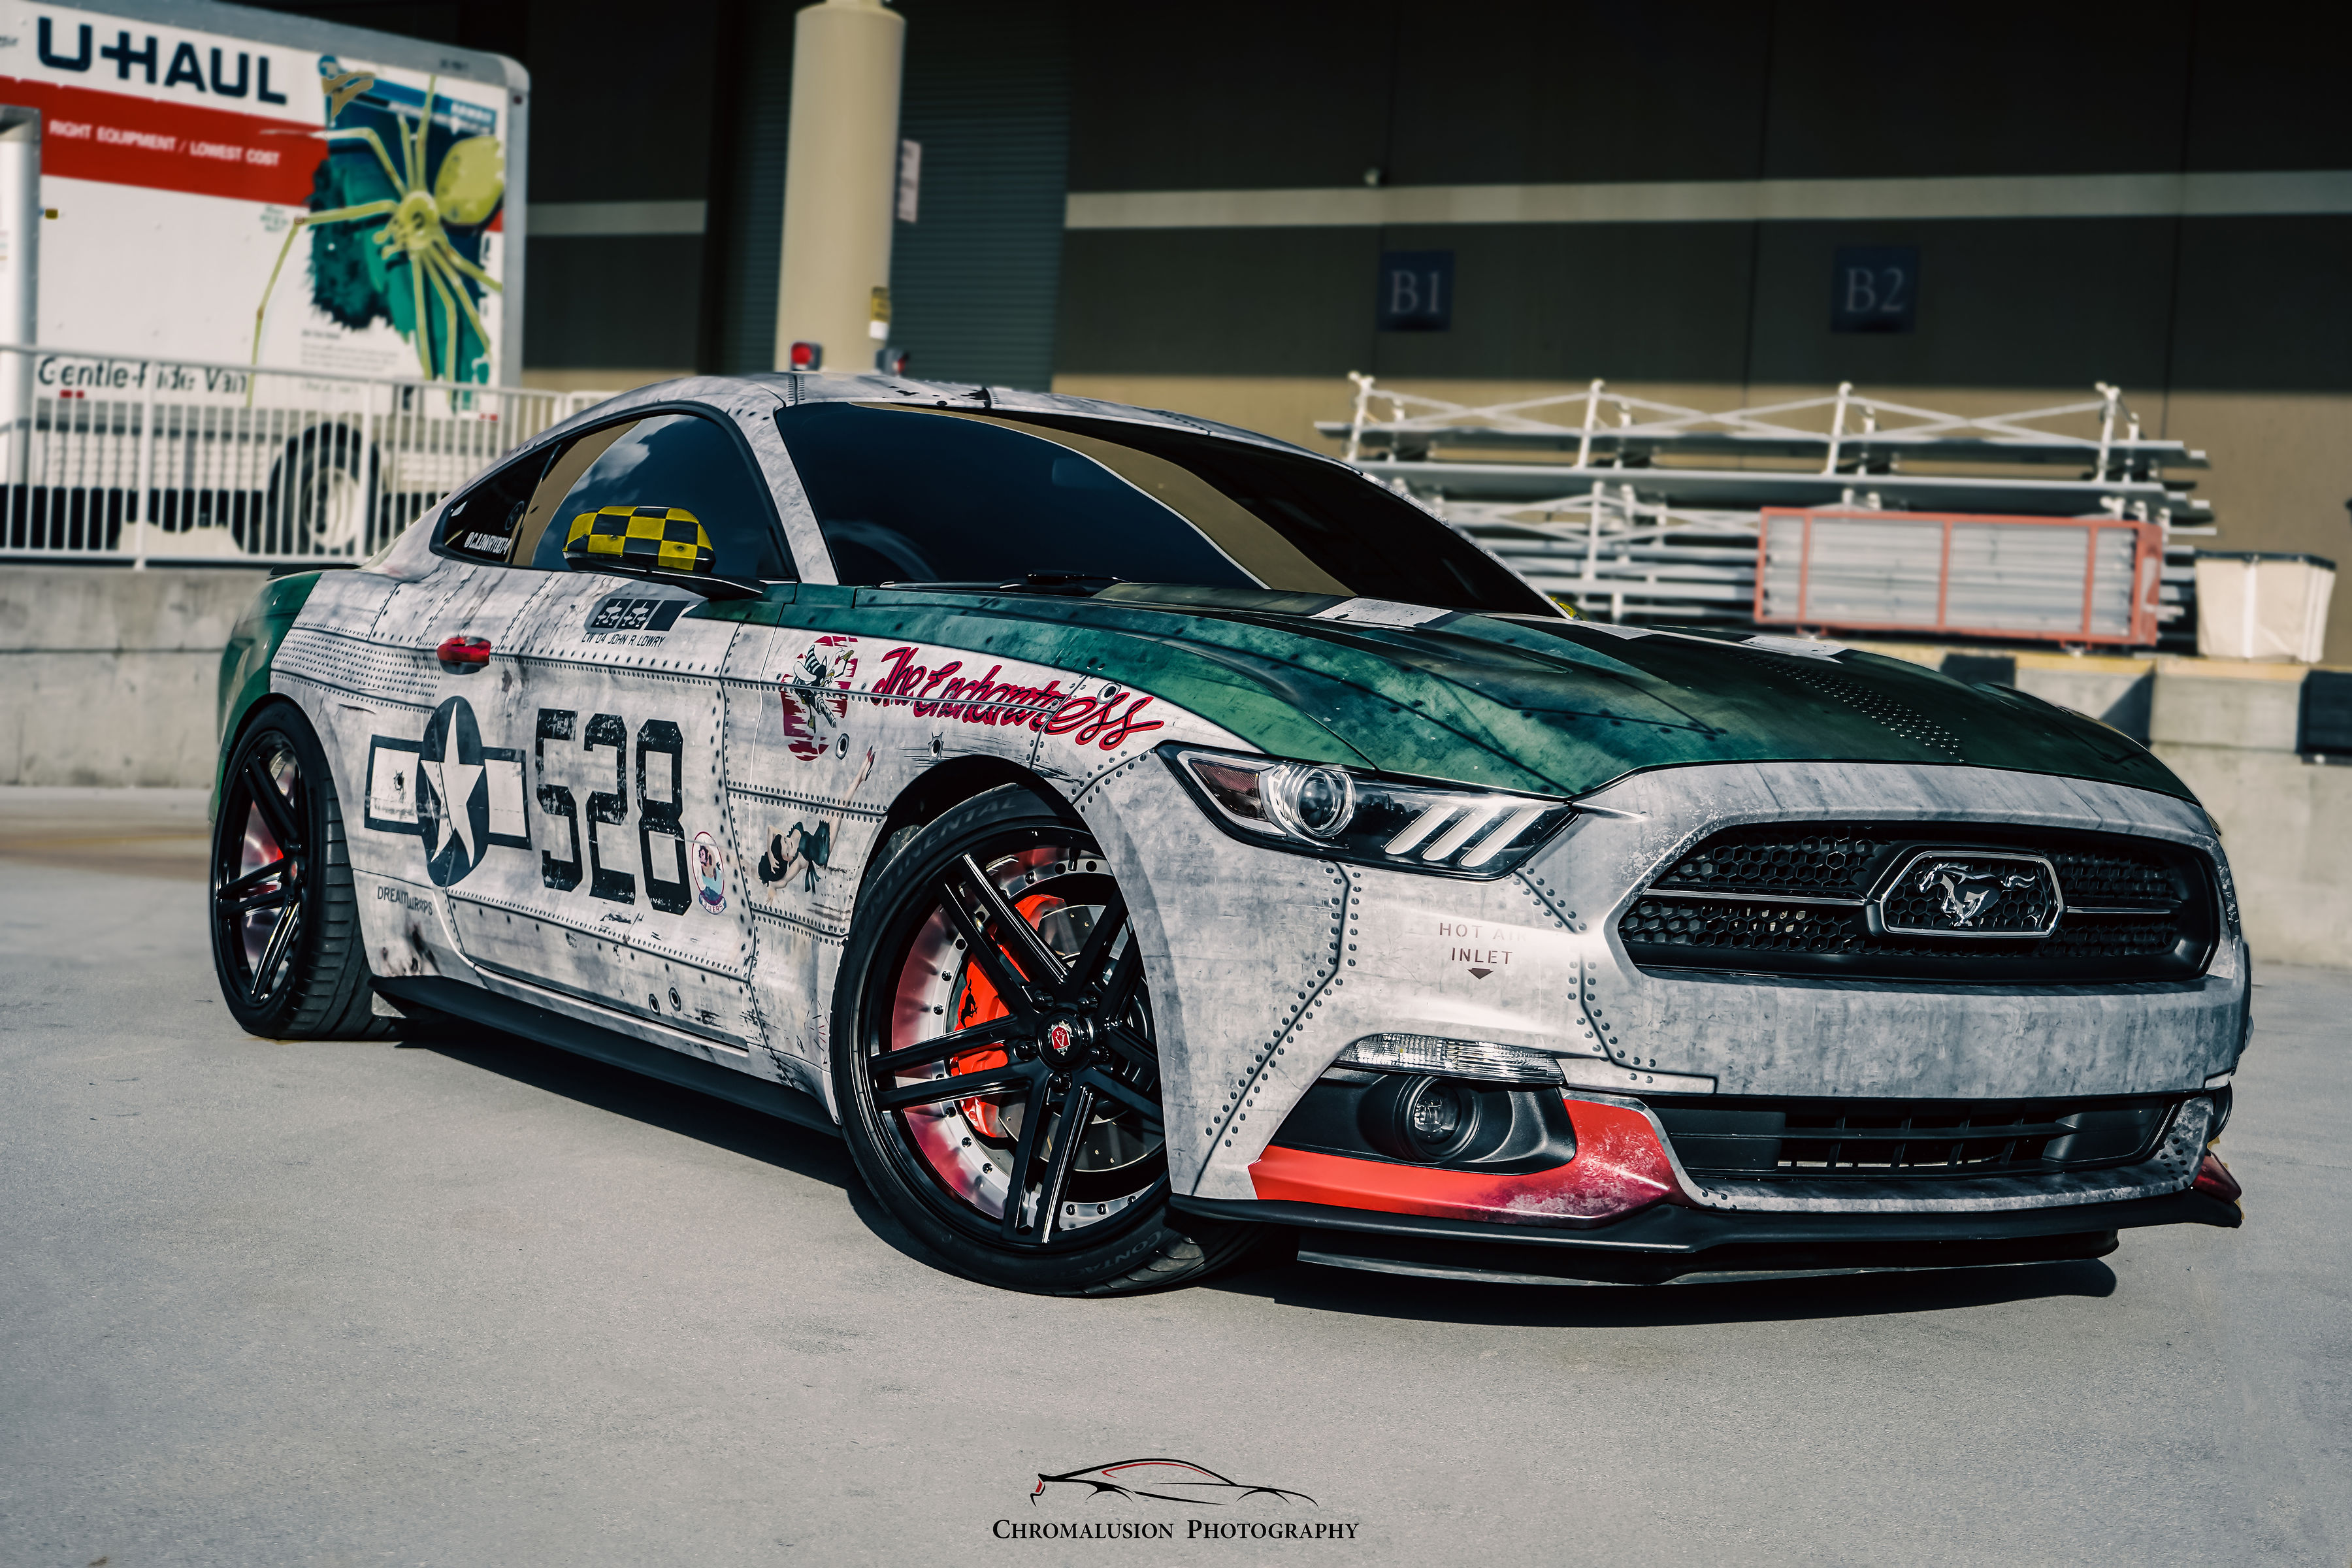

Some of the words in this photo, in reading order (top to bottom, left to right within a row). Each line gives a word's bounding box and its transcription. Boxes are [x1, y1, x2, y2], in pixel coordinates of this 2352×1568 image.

[37, 16, 287, 105] U-HAUL
[49, 120, 91, 140] RIGHT
[96, 126, 177, 152] EQUIPMENT
[189, 142, 242, 161] LOWEST
[246, 148, 281, 166] COST
[1390, 269, 1439, 313] B1
[1844, 266, 1905, 312] B2
[581, 632, 595, 643] CW
[595, 632, 608, 644] 04
[608, 634, 629, 645] JOHN
[629, 634, 637, 645] R
[636, 635, 666, 647] LOWRY
[870, 646, 928, 708] The
[535, 707, 693, 916] 528
[1439, 922, 1482, 938] HOT
[1492, 928, 1527, 941] AIR
[1452, 947, 1513, 964] INLET
